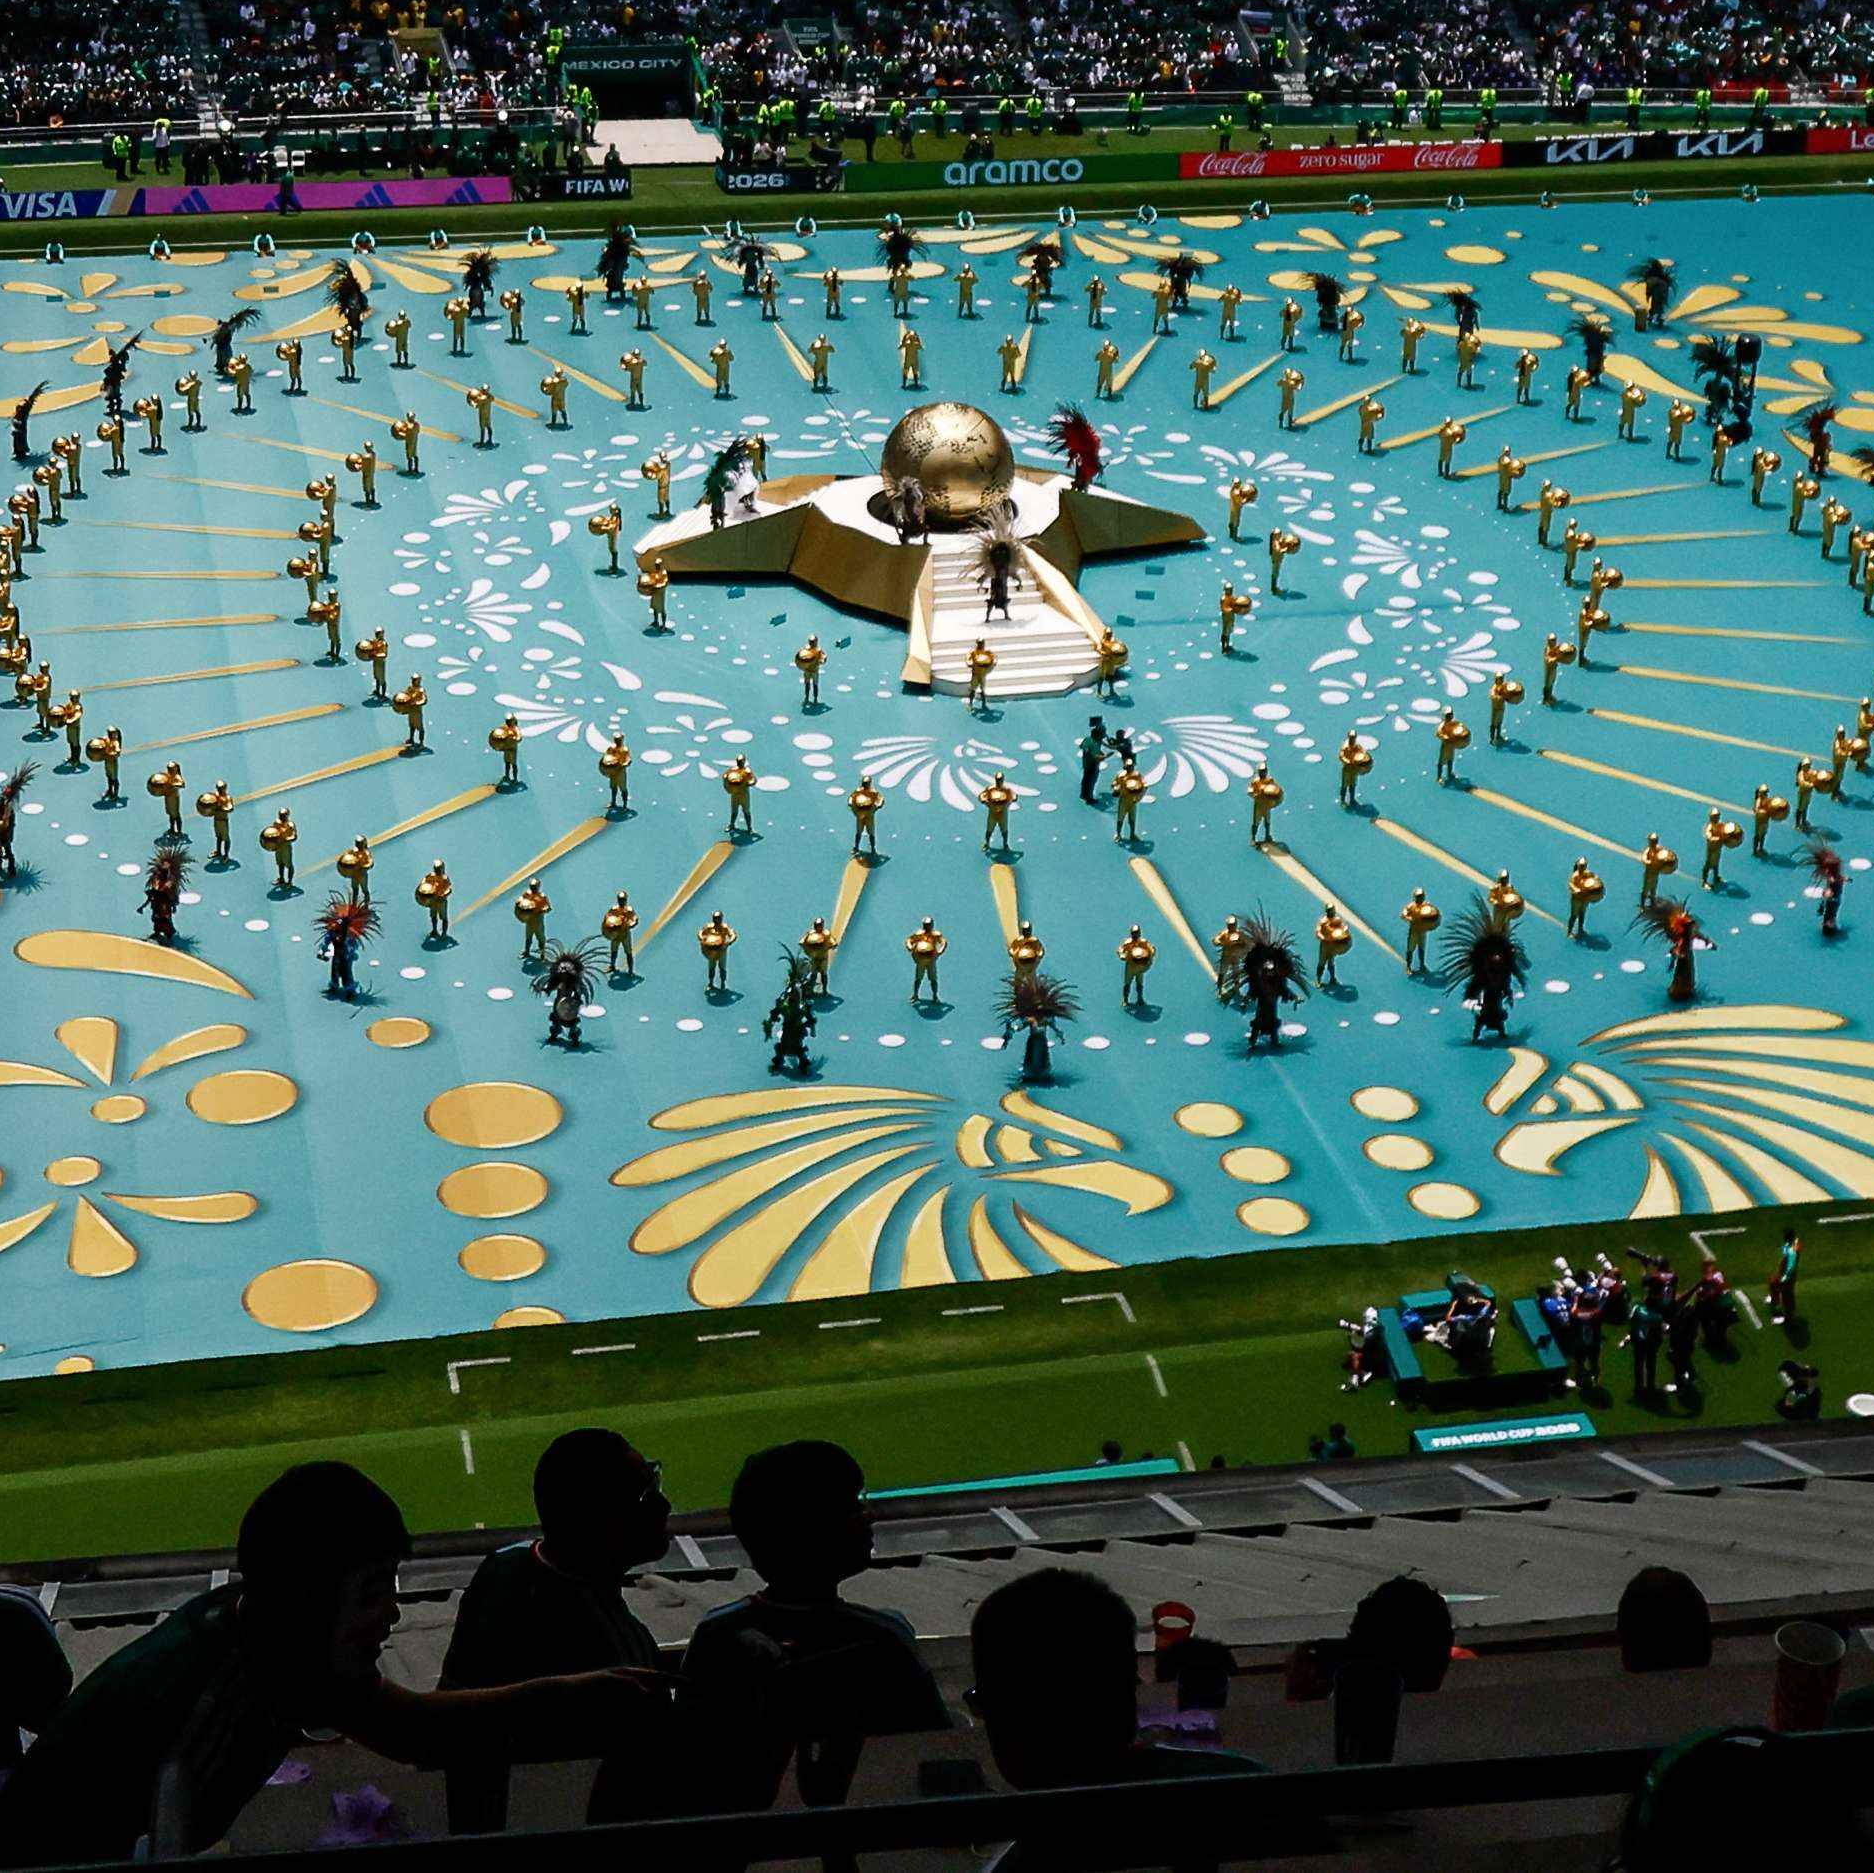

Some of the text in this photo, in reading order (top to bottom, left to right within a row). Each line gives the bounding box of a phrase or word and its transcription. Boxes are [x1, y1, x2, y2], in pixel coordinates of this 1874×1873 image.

[562, 58, 681, 70] MEXICO CITY
[1547, 137, 1635, 164] KIA
[1677, 133, 1767, 158] KIA
[944, 159, 1084, 186] aramco
[1299, 153, 1337, 170] zero
[1339, 152, 1386, 170] sugar
[565, 179, 629, 194] FIFA W
[0, 192, 78, 220] VISA
[1431, 1435, 1461, 1448] FIFA
[1461, 1430, 1507, 1444] WORLD
[1507, 1427, 1534, 1440] CUP
